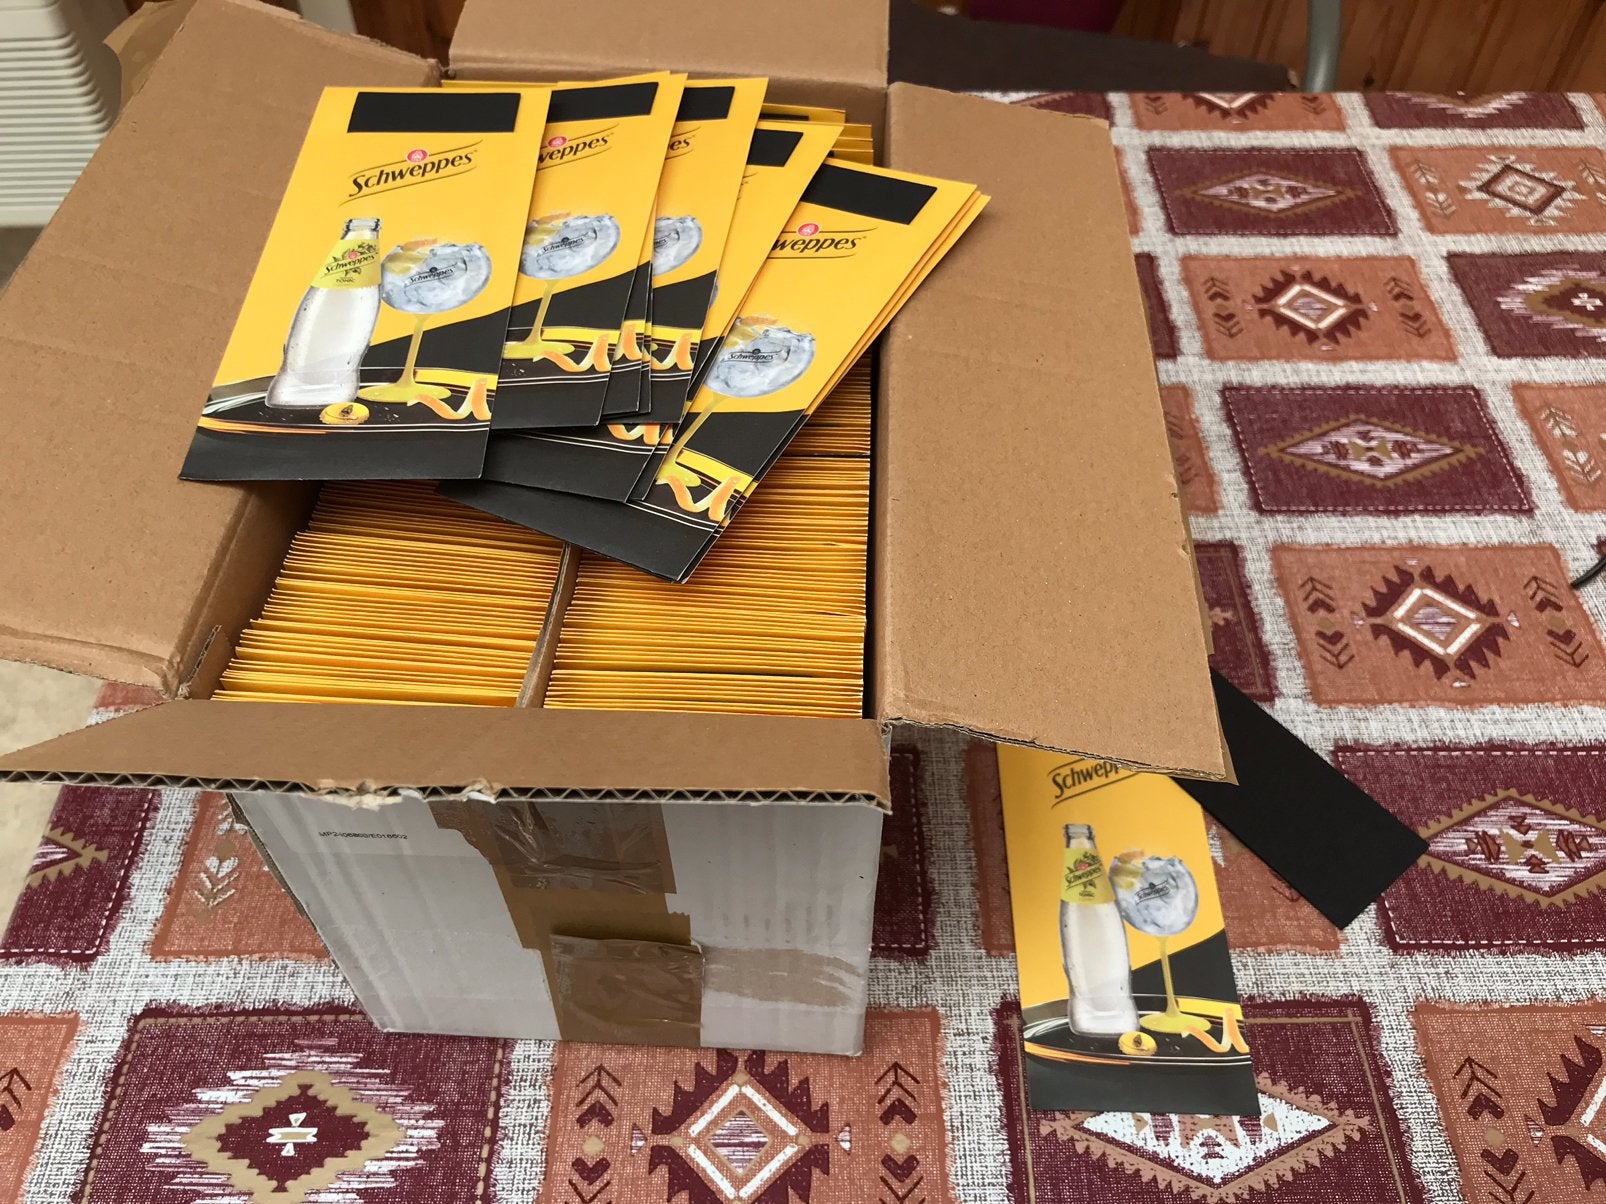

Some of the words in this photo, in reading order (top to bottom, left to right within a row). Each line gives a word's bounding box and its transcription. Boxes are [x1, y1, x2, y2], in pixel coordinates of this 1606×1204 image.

[349, 152, 474, 197] Schweppes
[771, 238, 857, 253] weppes
[326, 255, 375, 273] Schweppes
[1052, 761, 1118, 799] Schwep
